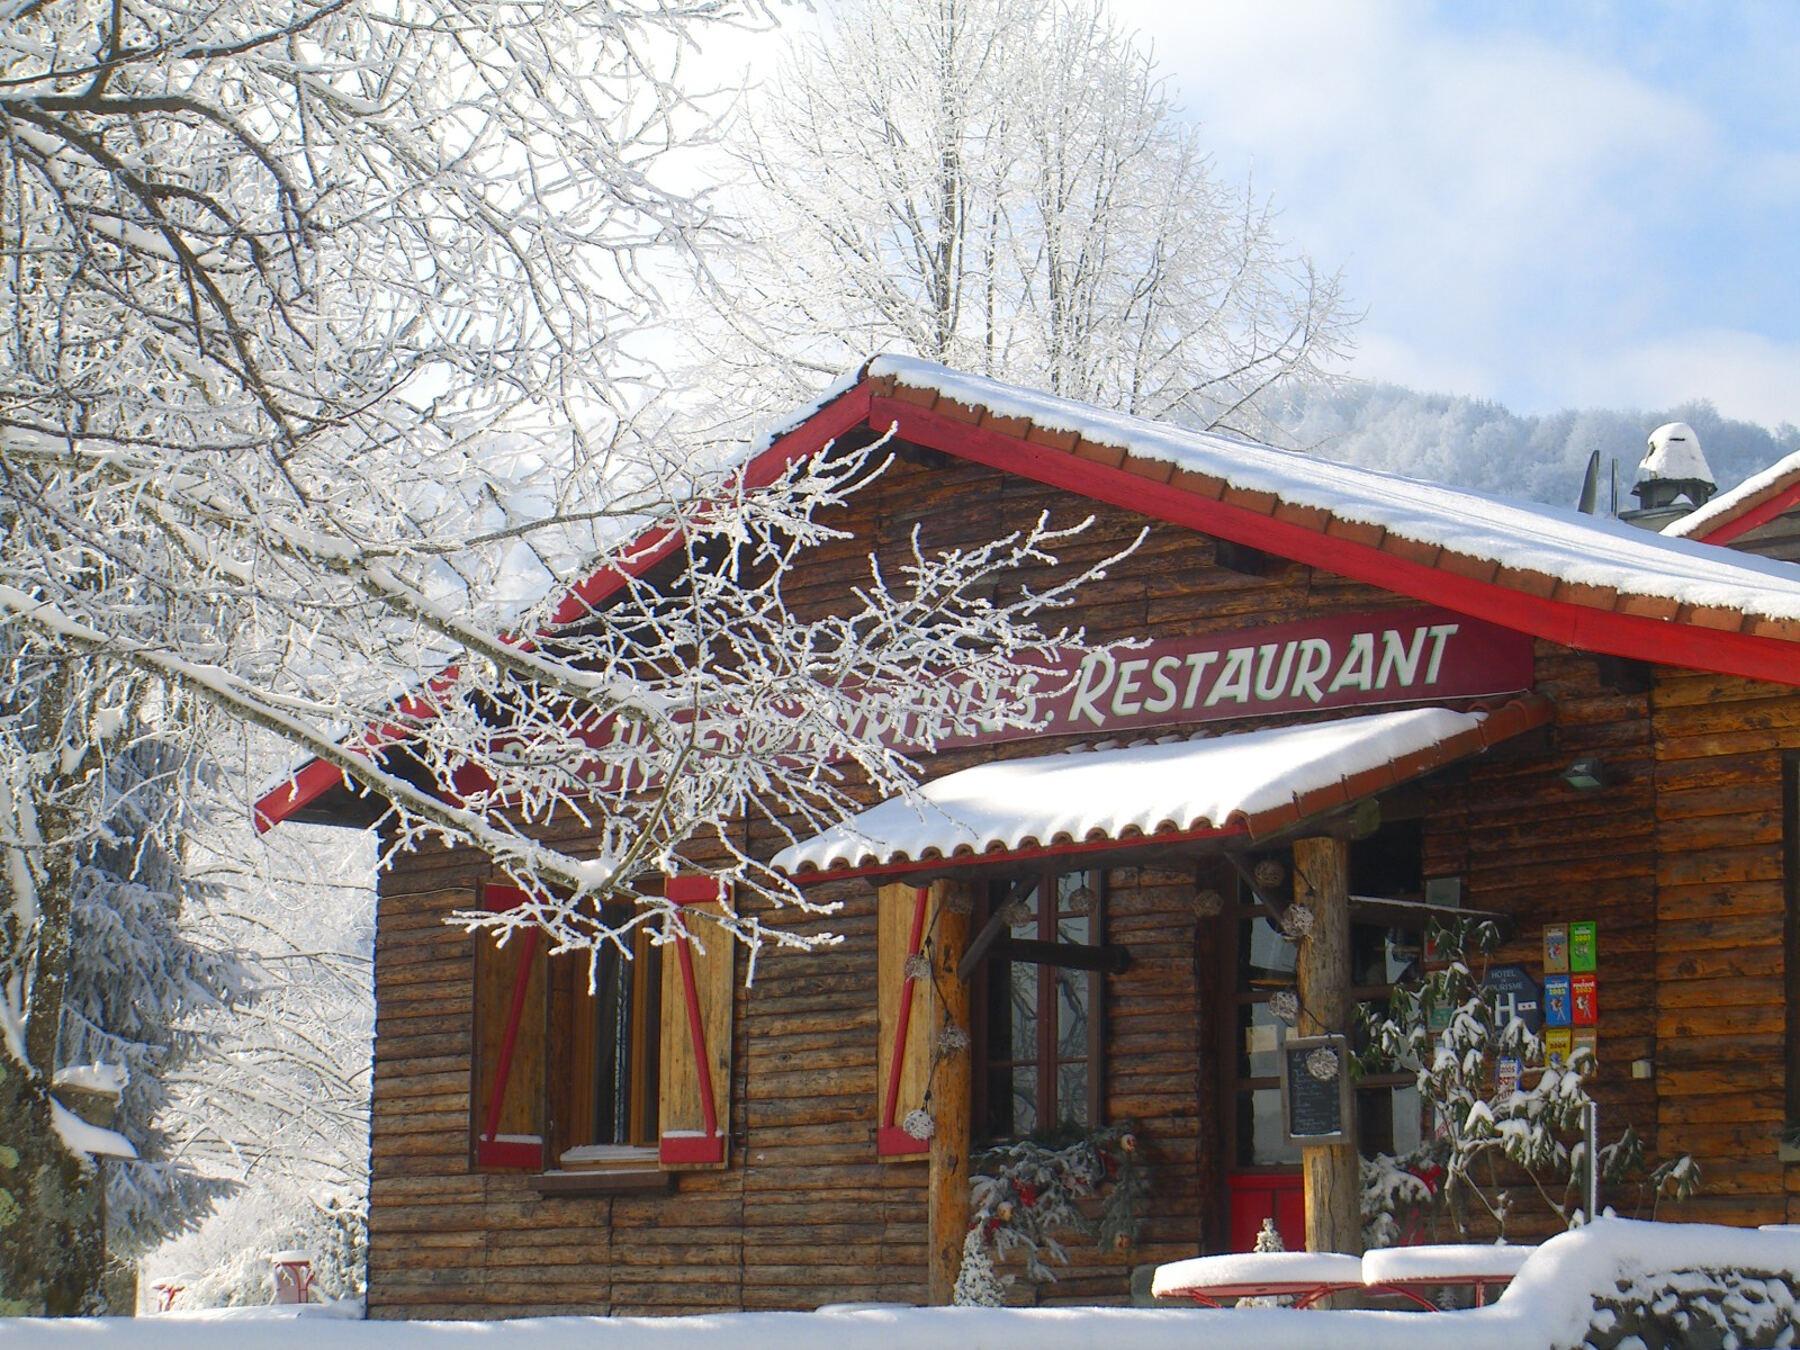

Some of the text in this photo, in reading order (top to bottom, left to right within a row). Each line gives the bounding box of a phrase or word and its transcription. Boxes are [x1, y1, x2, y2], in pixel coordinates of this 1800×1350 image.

[1066, 623, 1460, 728] RESTAURANT
[1491, 969, 1516, 979] HOTEL
[1495, 992, 1516, 1027] H
